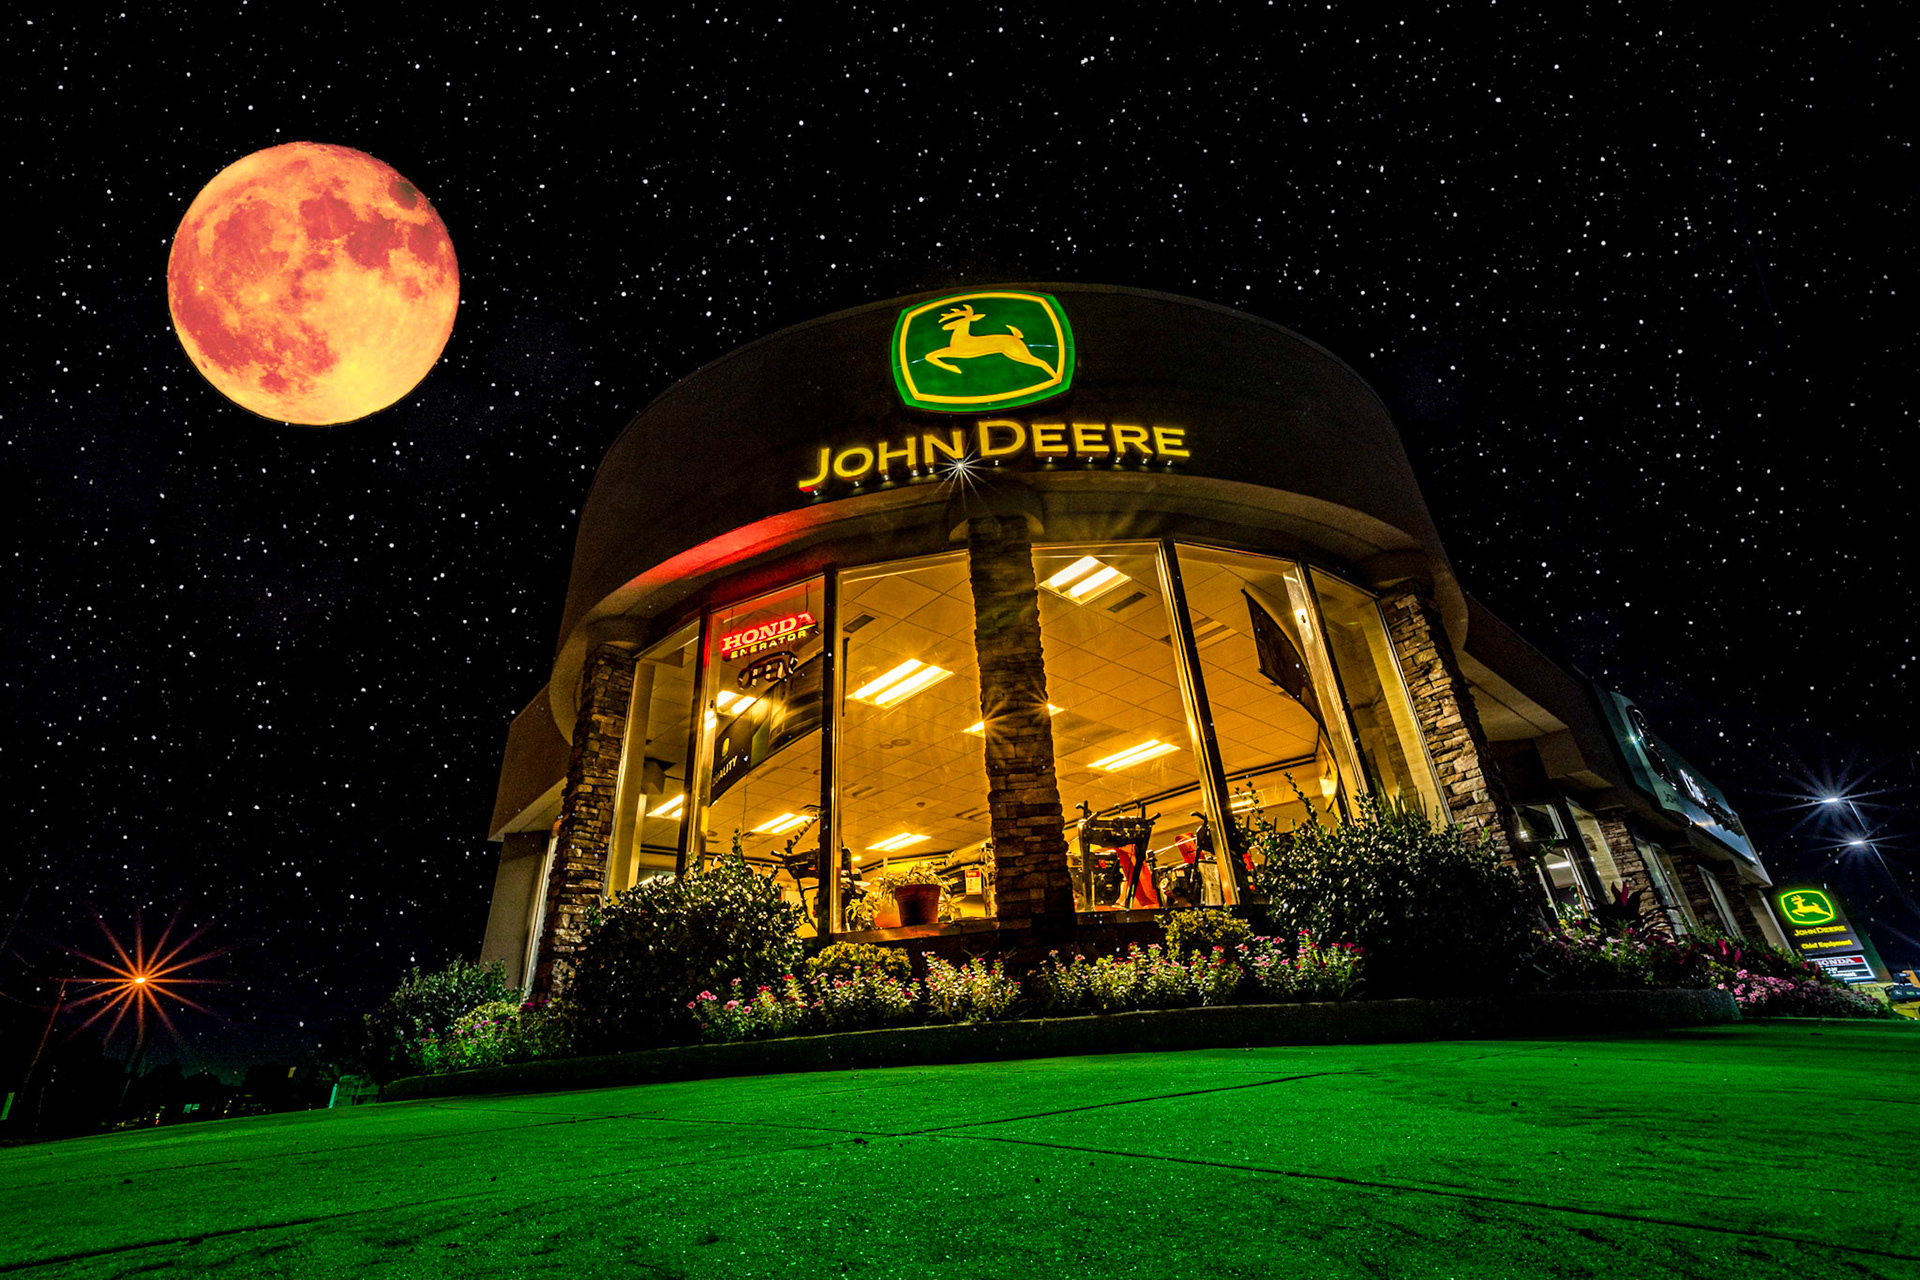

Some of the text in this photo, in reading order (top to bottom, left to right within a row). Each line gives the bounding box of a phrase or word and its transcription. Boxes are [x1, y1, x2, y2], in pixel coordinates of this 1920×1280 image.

[798, 420, 1191, 491] JOHN DEERE
[721, 613, 816, 651] HONDA
[1794, 925, 1847, 937] JOHN DEERE
[1818, 939, 1853, 948] Equipment
